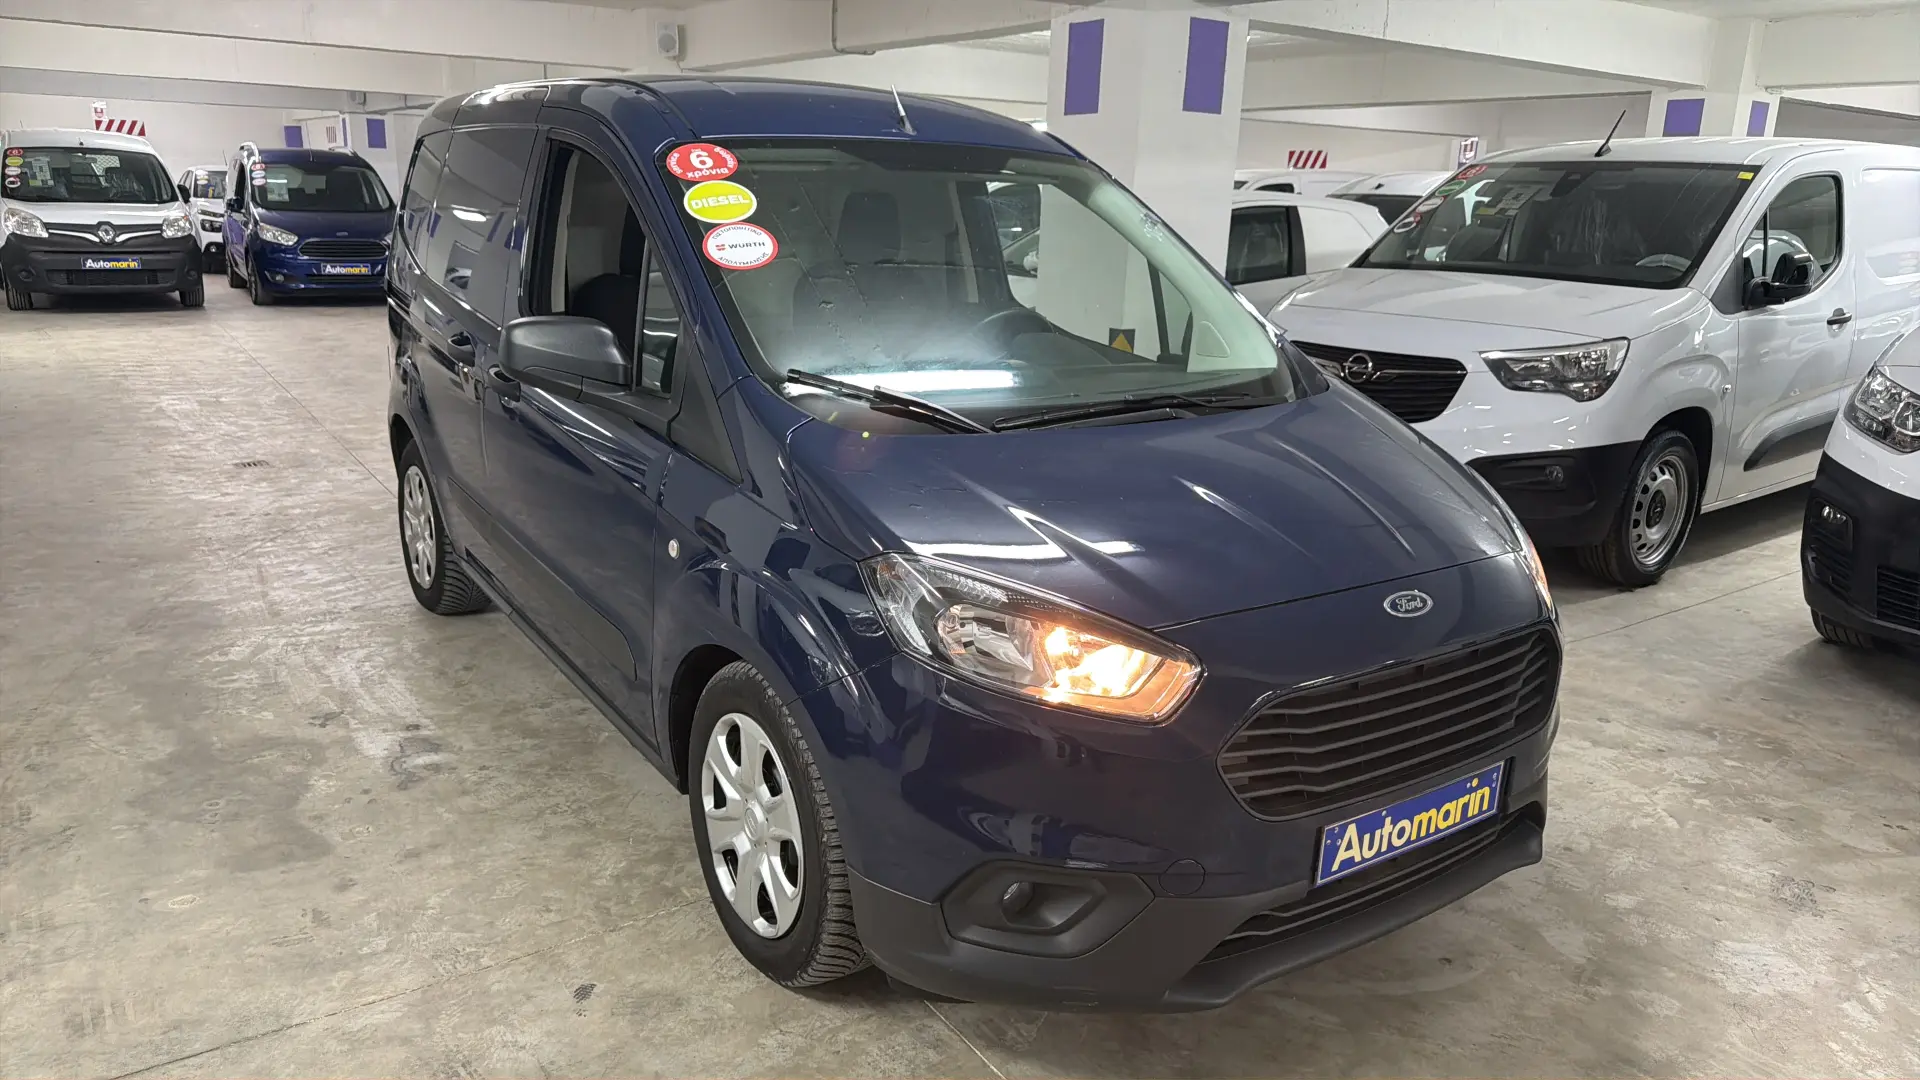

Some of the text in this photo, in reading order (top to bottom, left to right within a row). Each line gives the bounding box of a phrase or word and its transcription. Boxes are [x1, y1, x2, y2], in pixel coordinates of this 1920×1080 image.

[689, 150, 714, 169] 6
[685, 167, 729, 179] χρόνια
[690, 194, 751, 210] DIESEL
[85, 258, 139, 269] Automarin
[325, 263, 369, 274] Automarin
[1395, 595, 1424, 612] Ford
[1330, 777, 1491, 873] Automarin
